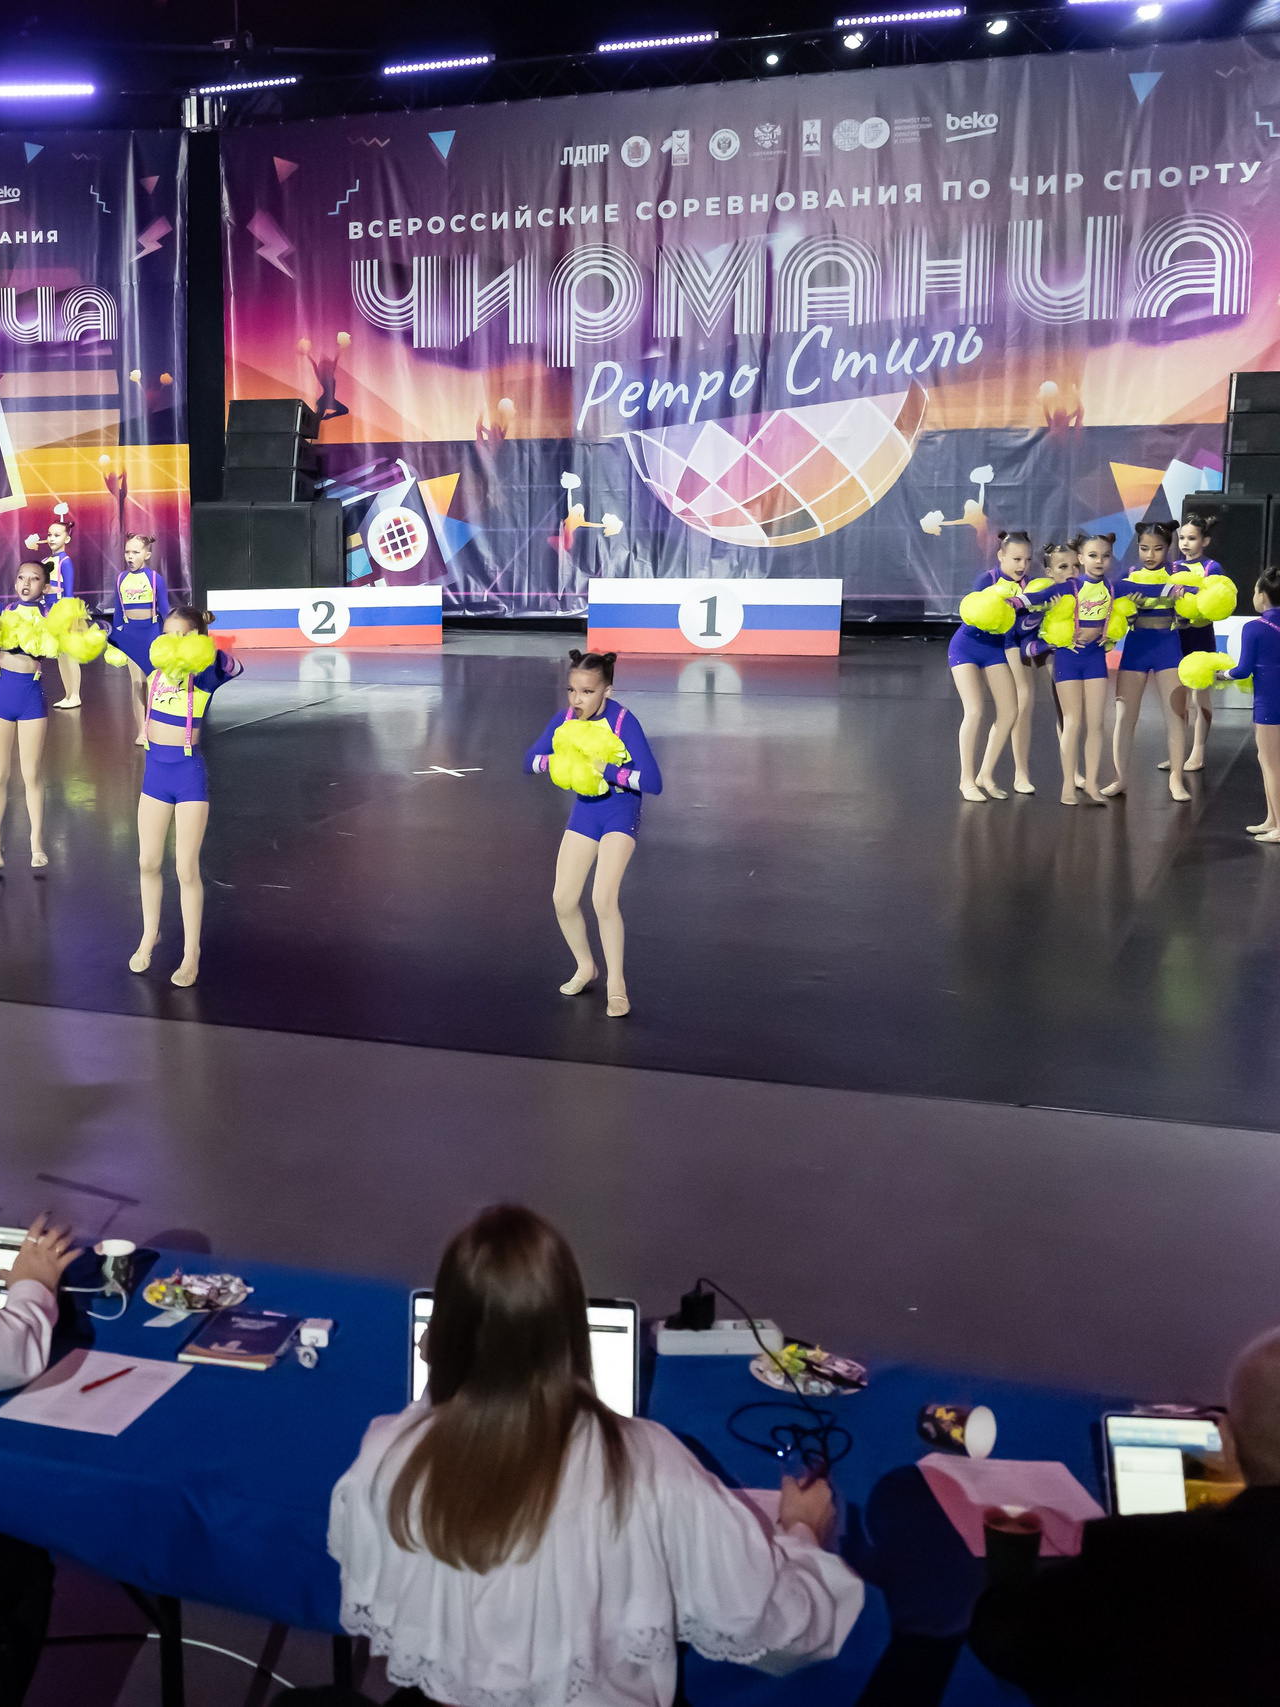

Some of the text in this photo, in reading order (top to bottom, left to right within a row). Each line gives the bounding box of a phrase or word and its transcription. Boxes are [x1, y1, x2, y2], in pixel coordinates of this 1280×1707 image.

[946, 111, 999, 131] beko
[560, 144, 610, 167] ЛДПР
[348, 160, 1262, 240] ВСЕРОССИЙСКИЕ СОРЕВНОВАНИЯ ПО ЧИР СПОРТУ
[576, 323, 985, 431] Ретро Стиль
[310, 600, 337, 635] 2
[697, 595, 722, 637] 1
